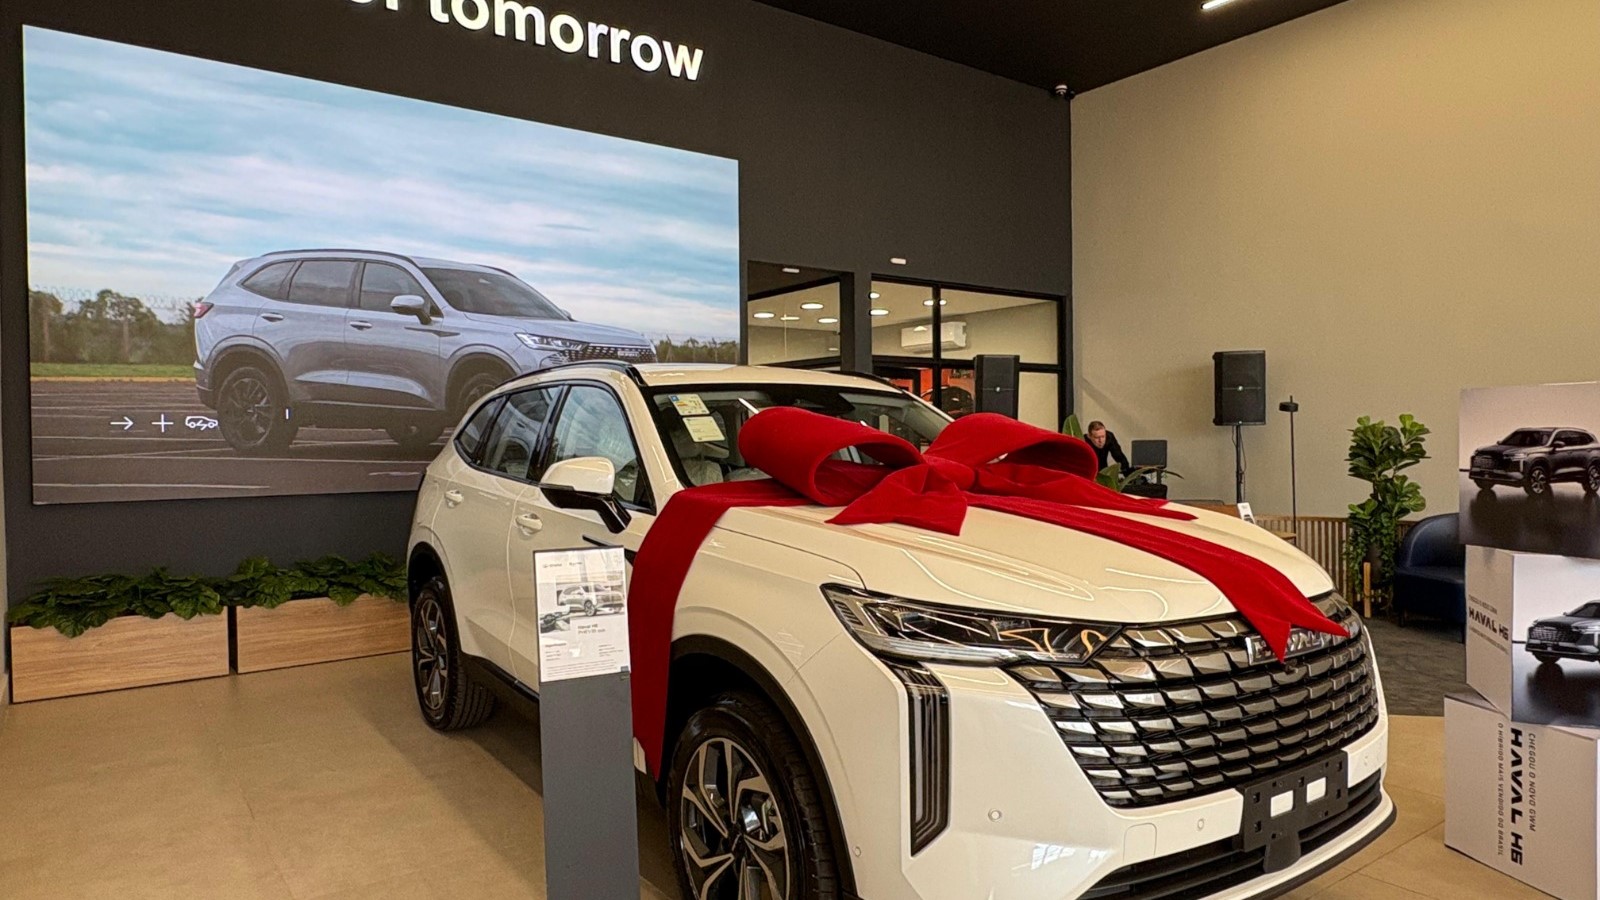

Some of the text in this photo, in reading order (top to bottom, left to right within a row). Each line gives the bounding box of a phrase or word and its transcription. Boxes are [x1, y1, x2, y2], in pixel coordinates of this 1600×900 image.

[1469, 606, 1498, 634] HAVAL
[1528, 733, 1536, 770] CHEGOU
[1511, 727, 1523, 866] HAVAL H6
[1528, 781, 1536, 807] NOVO
[1528, 808, 1536, 832] GWM
